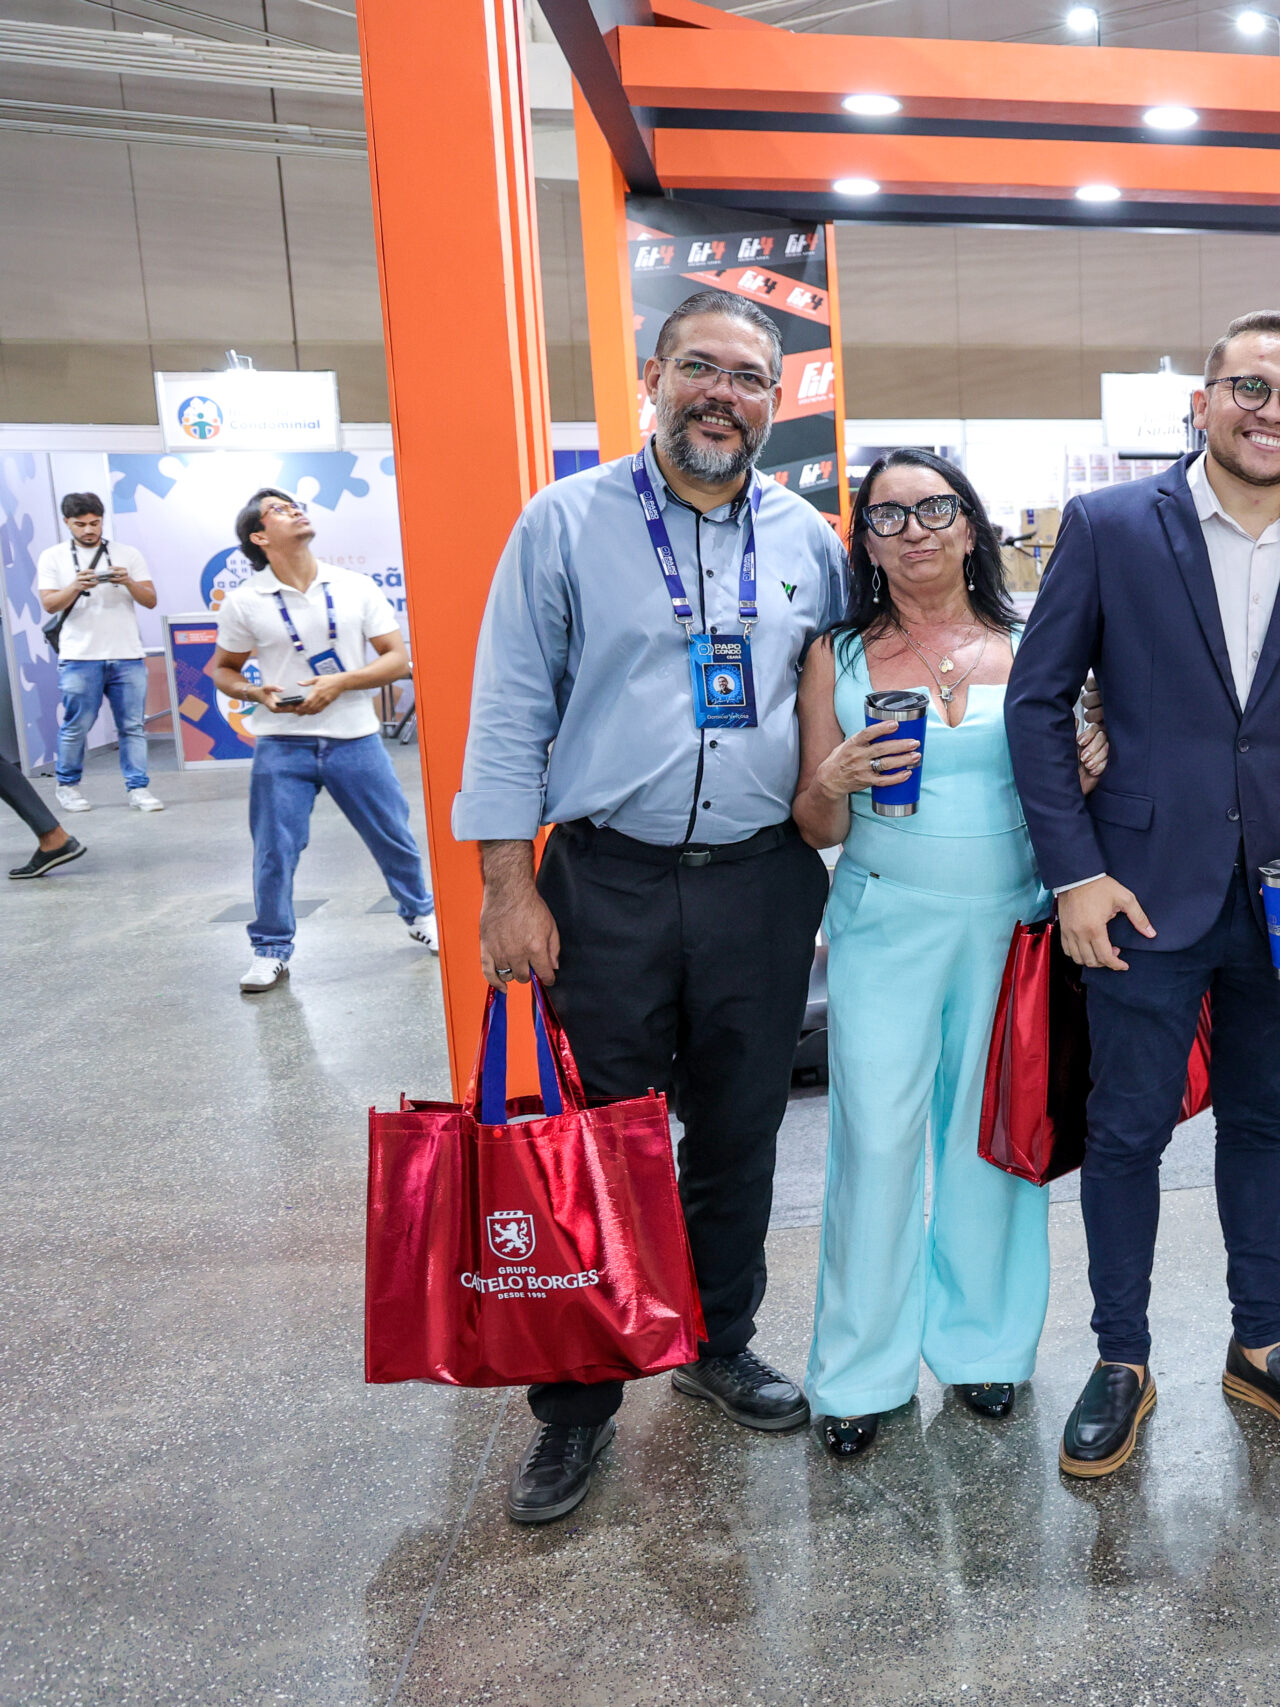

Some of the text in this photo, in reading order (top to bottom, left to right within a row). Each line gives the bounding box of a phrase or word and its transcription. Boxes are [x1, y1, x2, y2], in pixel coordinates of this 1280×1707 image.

[229, 419, 321, 430] Condominial
[498, 1266, 537, 1275] GRUPO
[526, 1269, 600, 1290] BORGES
[497, 1292, 526, 1300] DESDE
